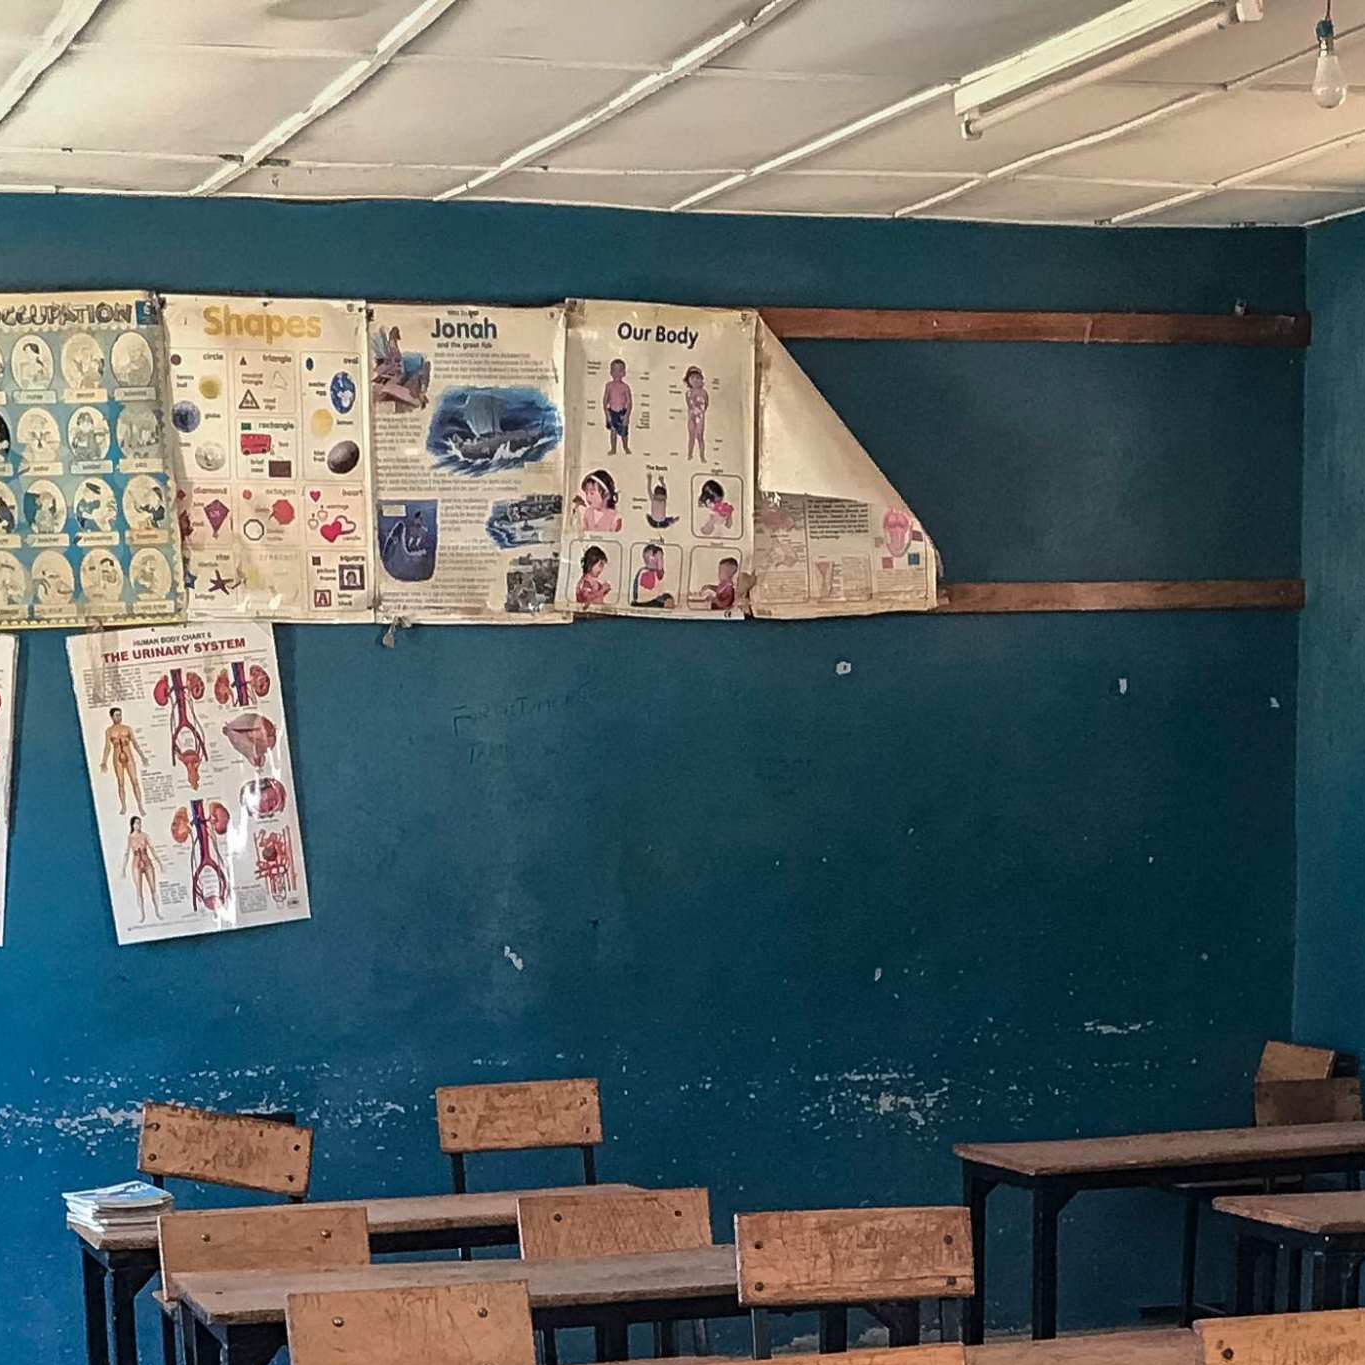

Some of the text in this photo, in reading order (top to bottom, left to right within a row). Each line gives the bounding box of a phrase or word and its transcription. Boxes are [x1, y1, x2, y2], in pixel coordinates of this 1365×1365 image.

[203, 304, 323, 345] Shapes
[430, 316, 497, 339] Jonah
[617, 322, 700, 349] Our Body
[203, 353, 223, 361] circle
[262, 354, 292, 364] triangle
[258, 421, 295, 431] rectangle
[318, 592, 328, 605] A
[132, 637, 159, 647] HUMAN
[160, 635, 181, 645] BODY
[181, 633, 205, 643] CHART
[102, 638, 246, 664] THE URINARY SYSTEM
